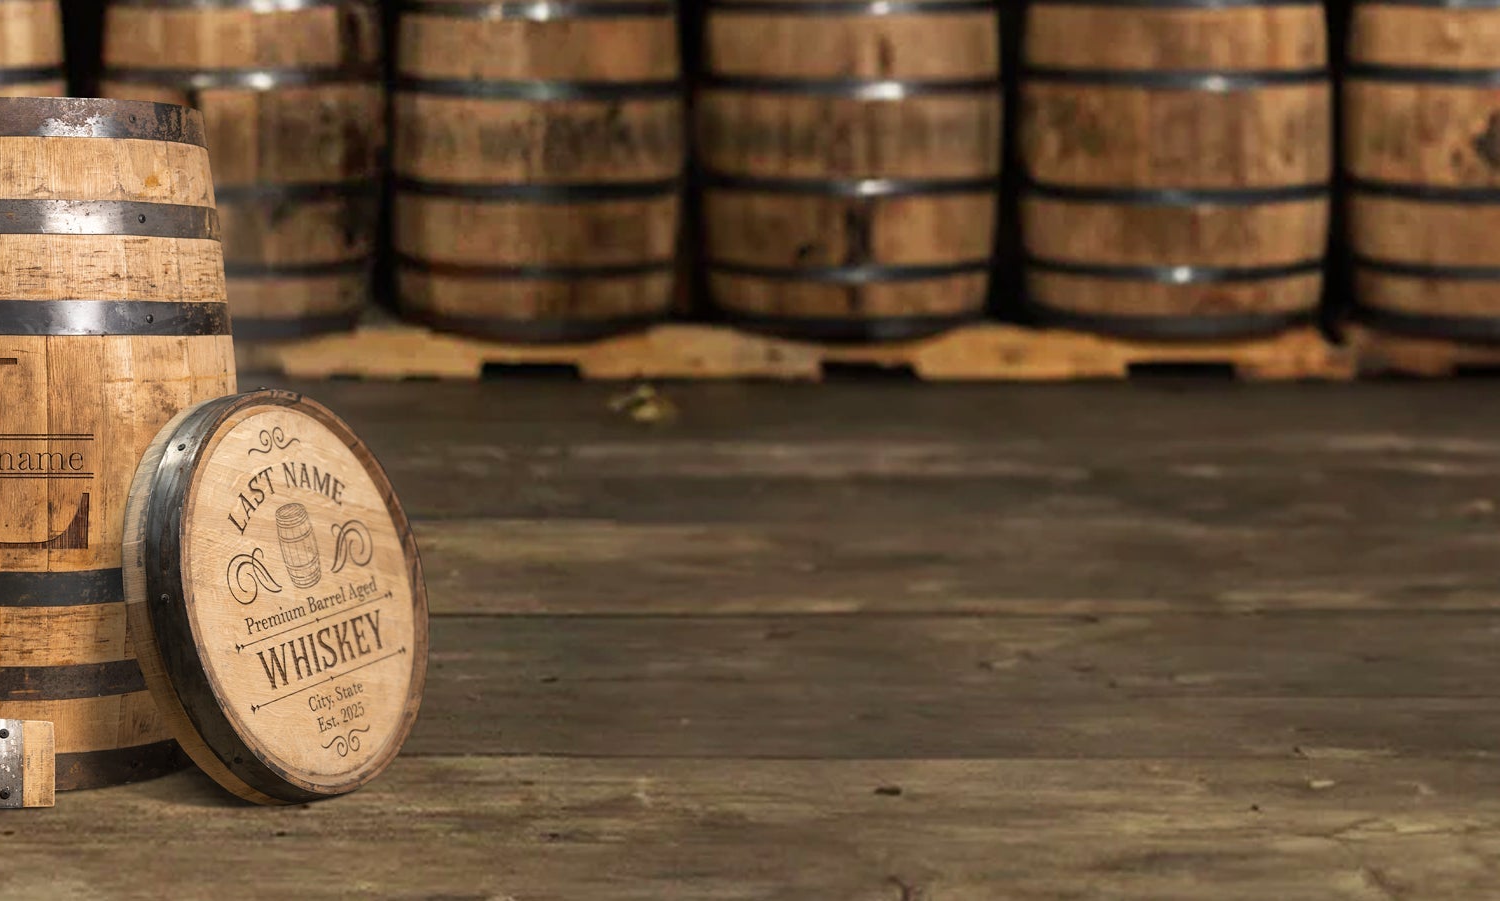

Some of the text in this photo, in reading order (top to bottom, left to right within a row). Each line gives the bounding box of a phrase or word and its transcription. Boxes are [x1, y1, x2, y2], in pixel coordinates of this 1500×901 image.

[227, 461, 345, 535] LAST NAME
[244, 576, 378, 635] Premium Barrel Aged
[256, 609, 383, 691] WHISKEY
[308, 682, 364, 712] City, State
[317, 701, 365, 733] Est. 2025
